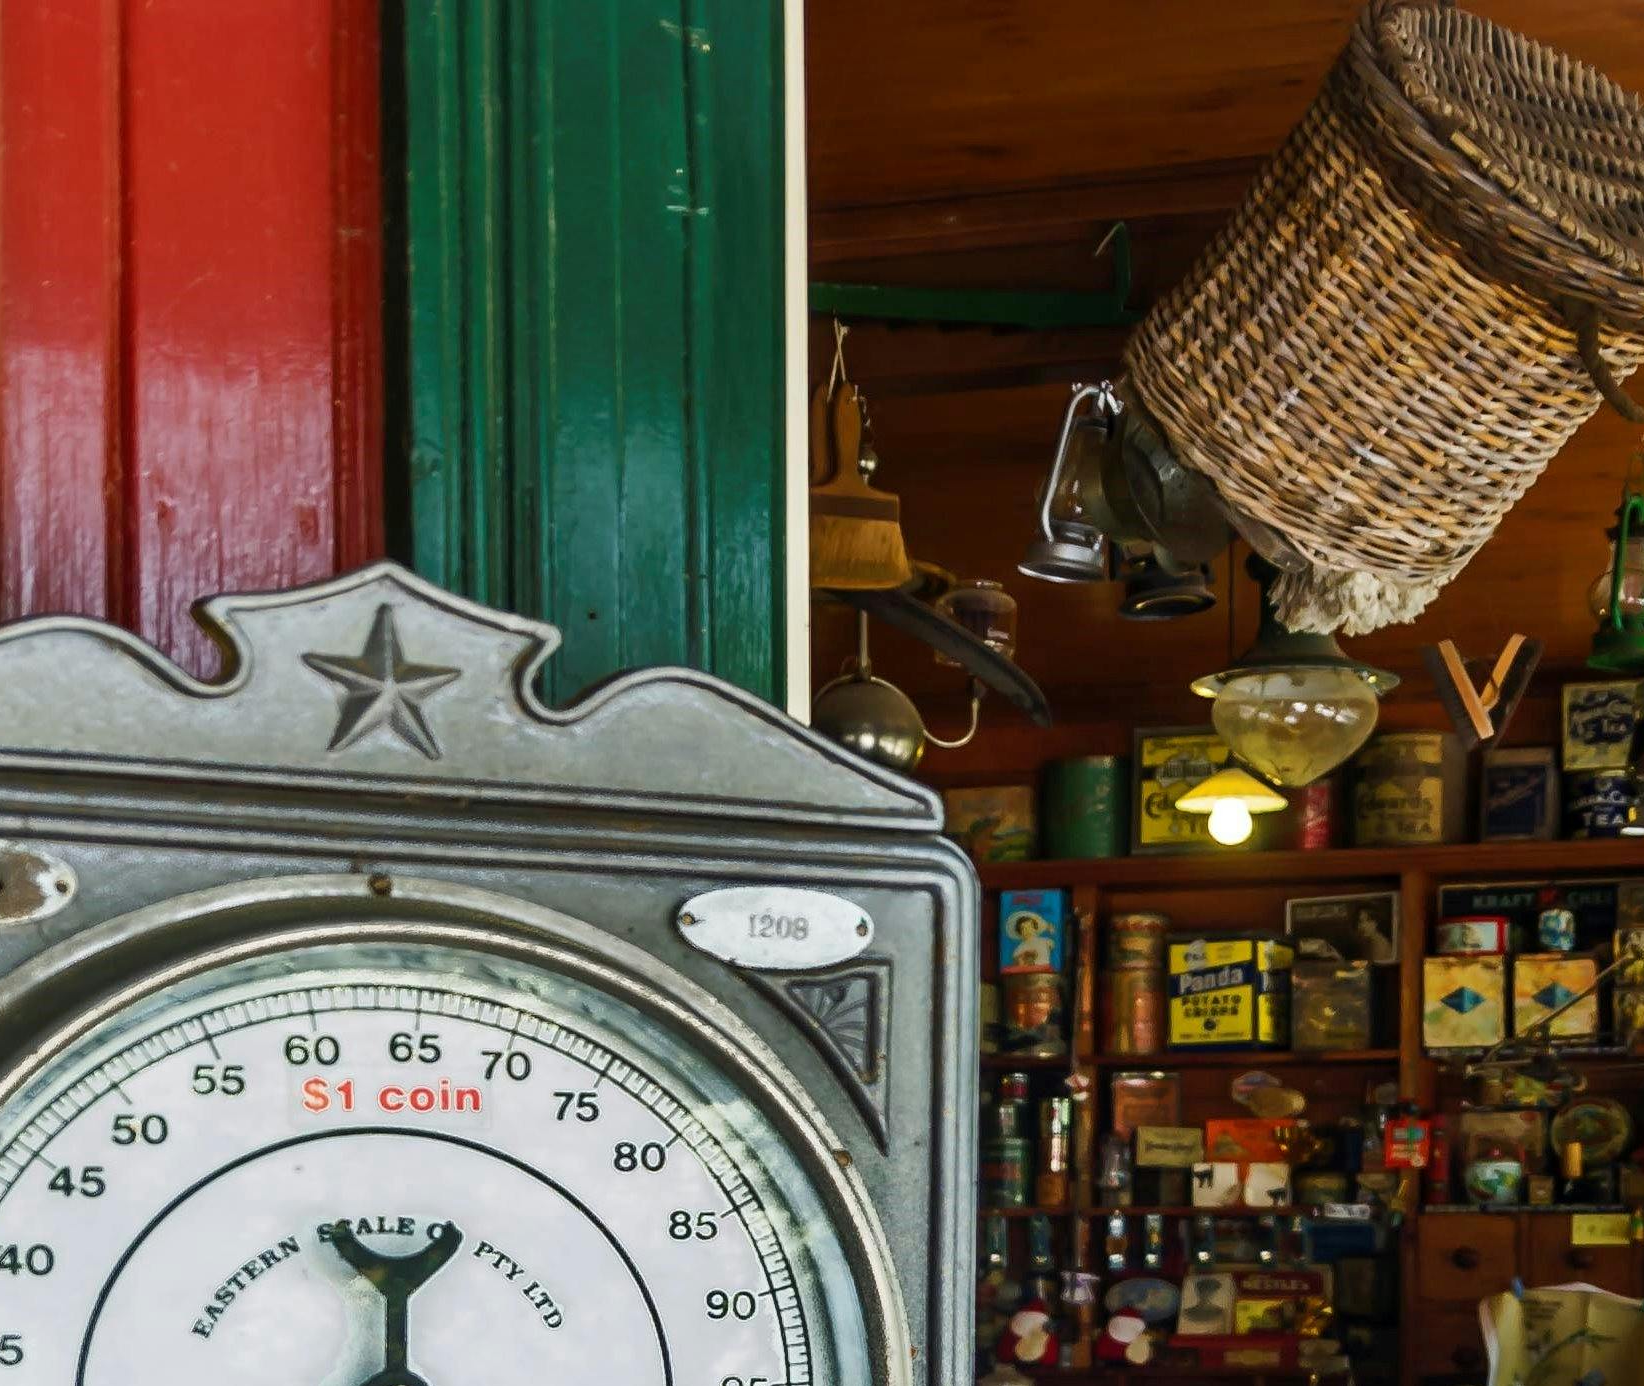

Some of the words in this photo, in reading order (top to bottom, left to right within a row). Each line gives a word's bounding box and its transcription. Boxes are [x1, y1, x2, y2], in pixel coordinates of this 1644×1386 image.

[1583, 811, 1625, 827] TEA
[1180, 966, 1244, 995] Panda
[283, 1033, 343, 1068] 60
[387, 1032, 442, 1066] 65
[480, 1048, 532, 1083] 70
[191, 1063, 246, 1097] 55
[301, 1076, 357, 1117] $1
[378, 1076, 483, 1115] coin
[552, 1091, 600, 1124] 75
[112, 1113, 169, 1147] 50
[612, 1140, 668, 1176] 80
[48, 1166, 106, 1201] 45
[666, 1209, 721, 1242] 85
[192, 1236, 301, 1339] EASTERN
[317, 1217, 415, 1243] SALE
[473, 1241, 524, 1281] PTY
[523, 1282, 564, 1330] LTD
[705, 1289, 757, 1323] 90
